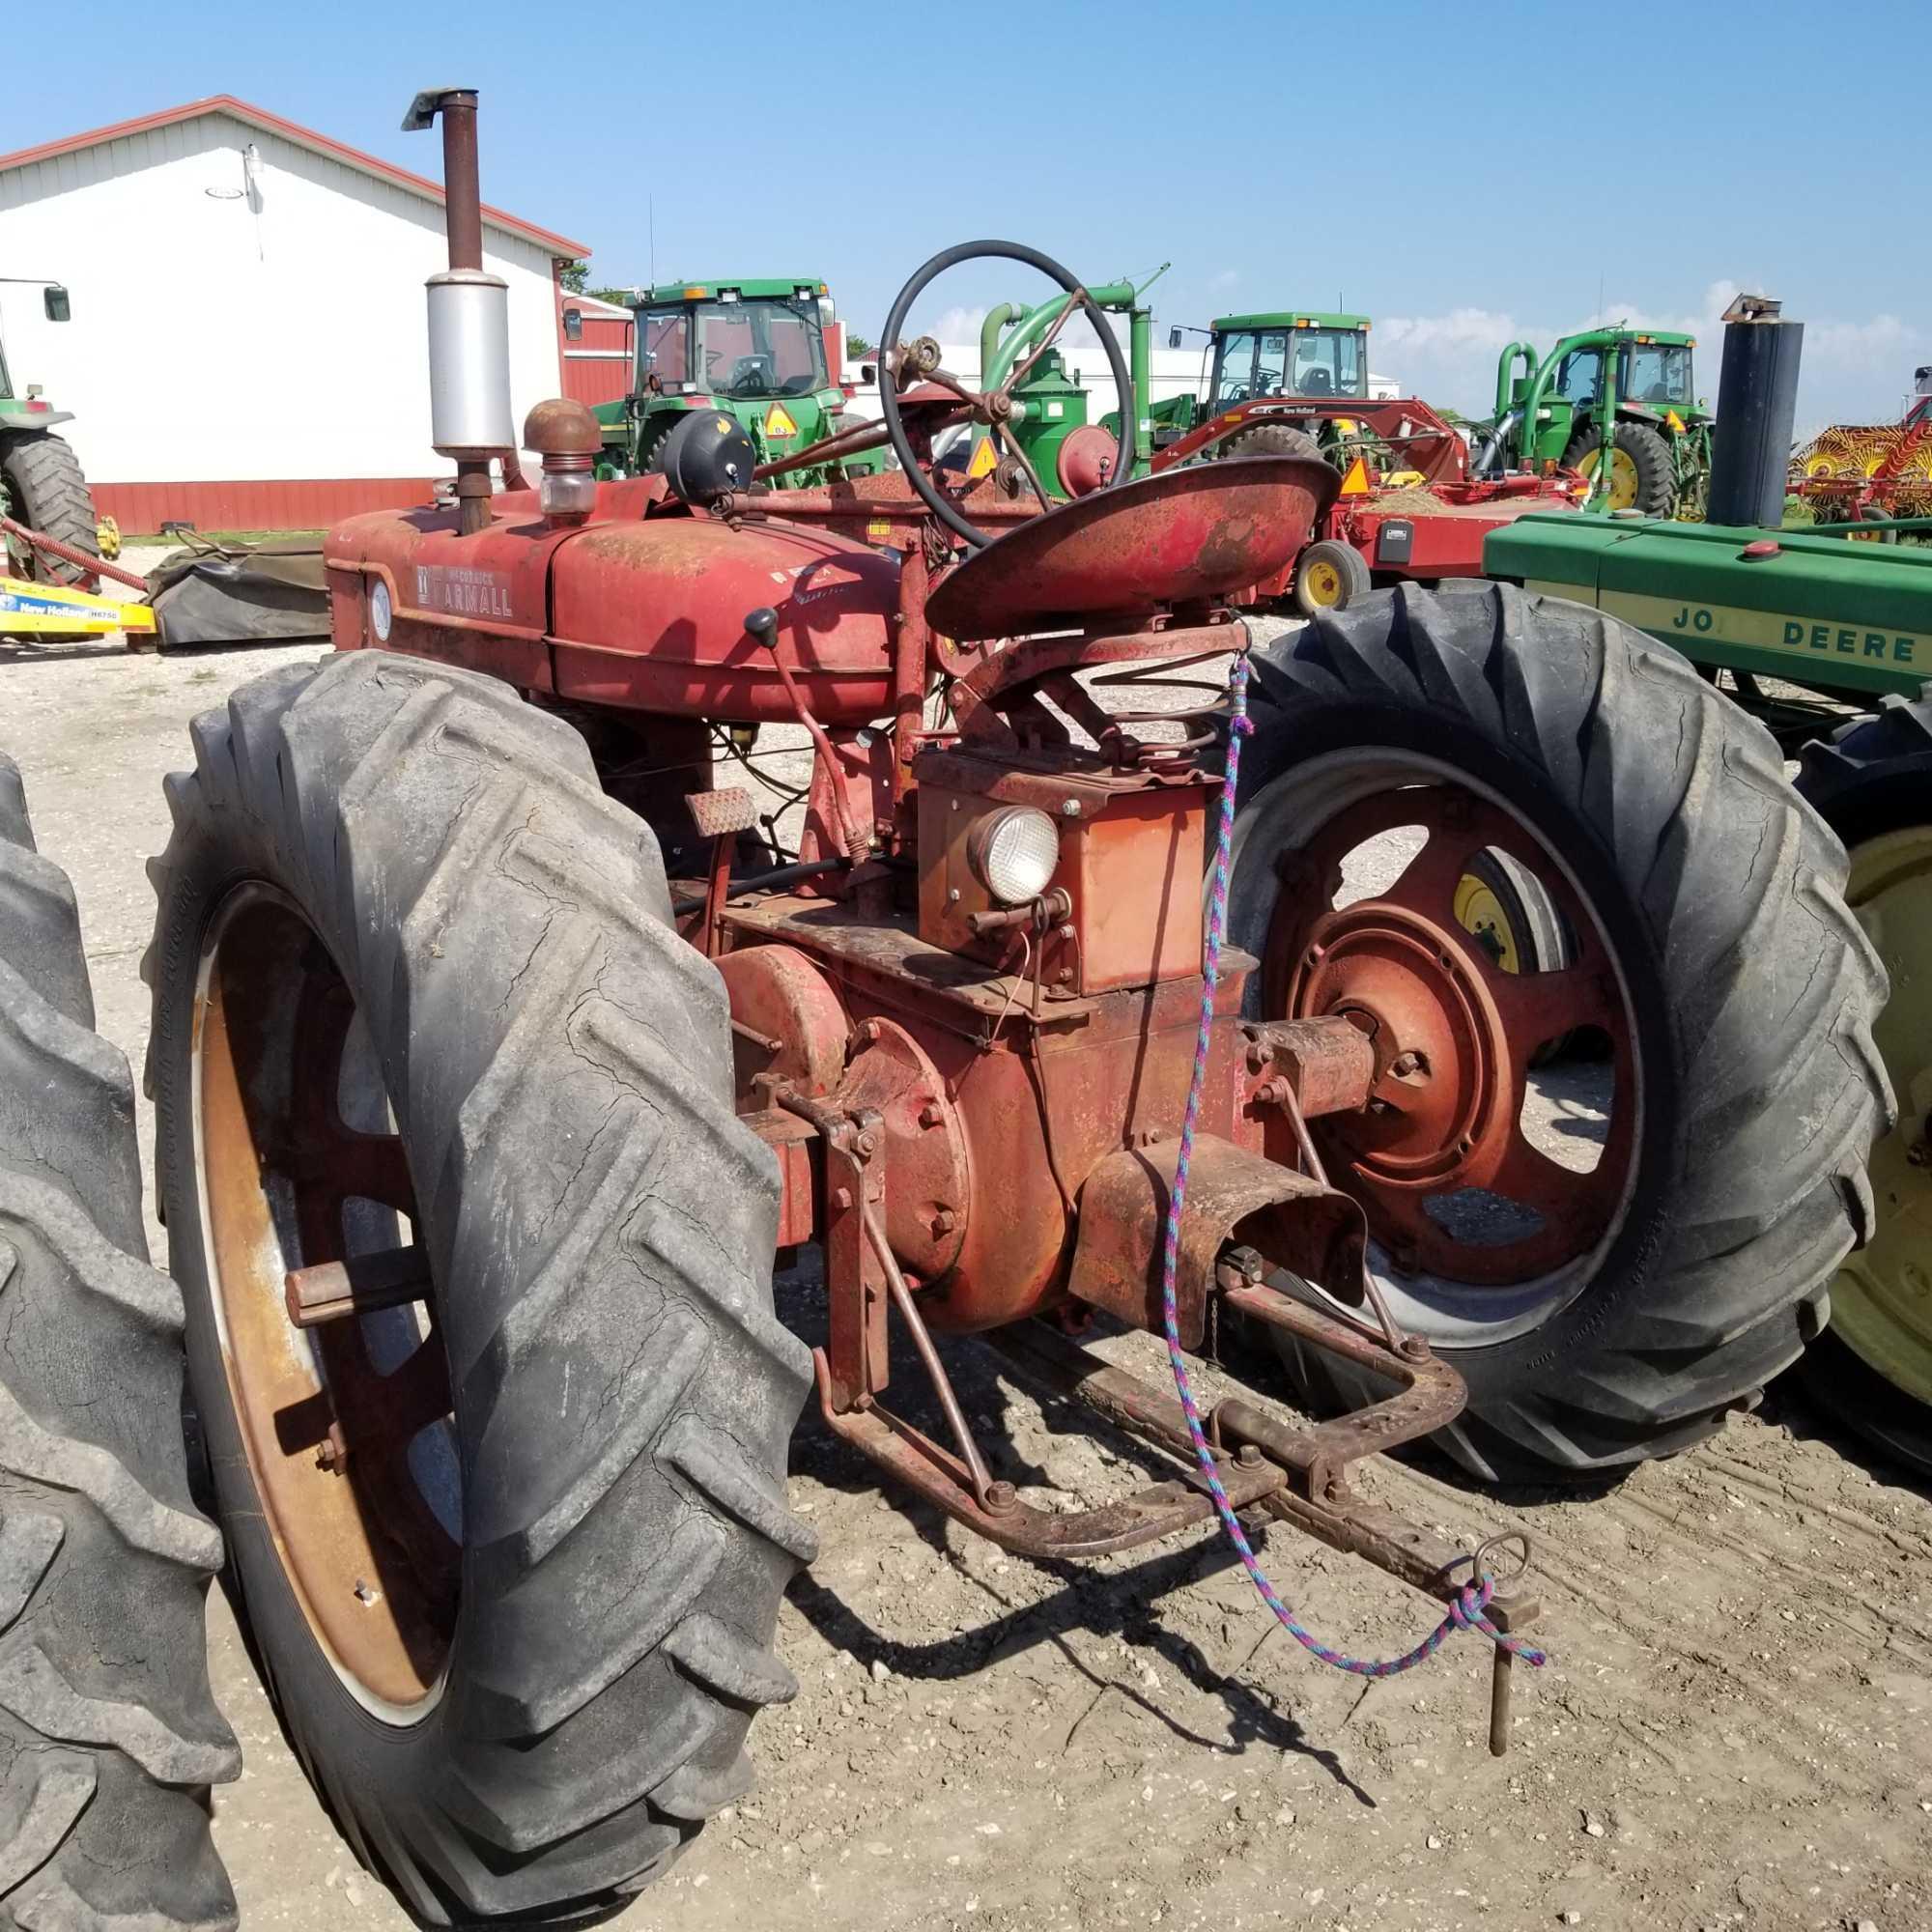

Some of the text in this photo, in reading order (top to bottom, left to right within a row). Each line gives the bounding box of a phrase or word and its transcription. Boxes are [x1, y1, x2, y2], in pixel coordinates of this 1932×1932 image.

[19, 603, 45, 613] New
[46, 605, 90, 618] Holland
[1783, 621, 1917, 663] DEERE
